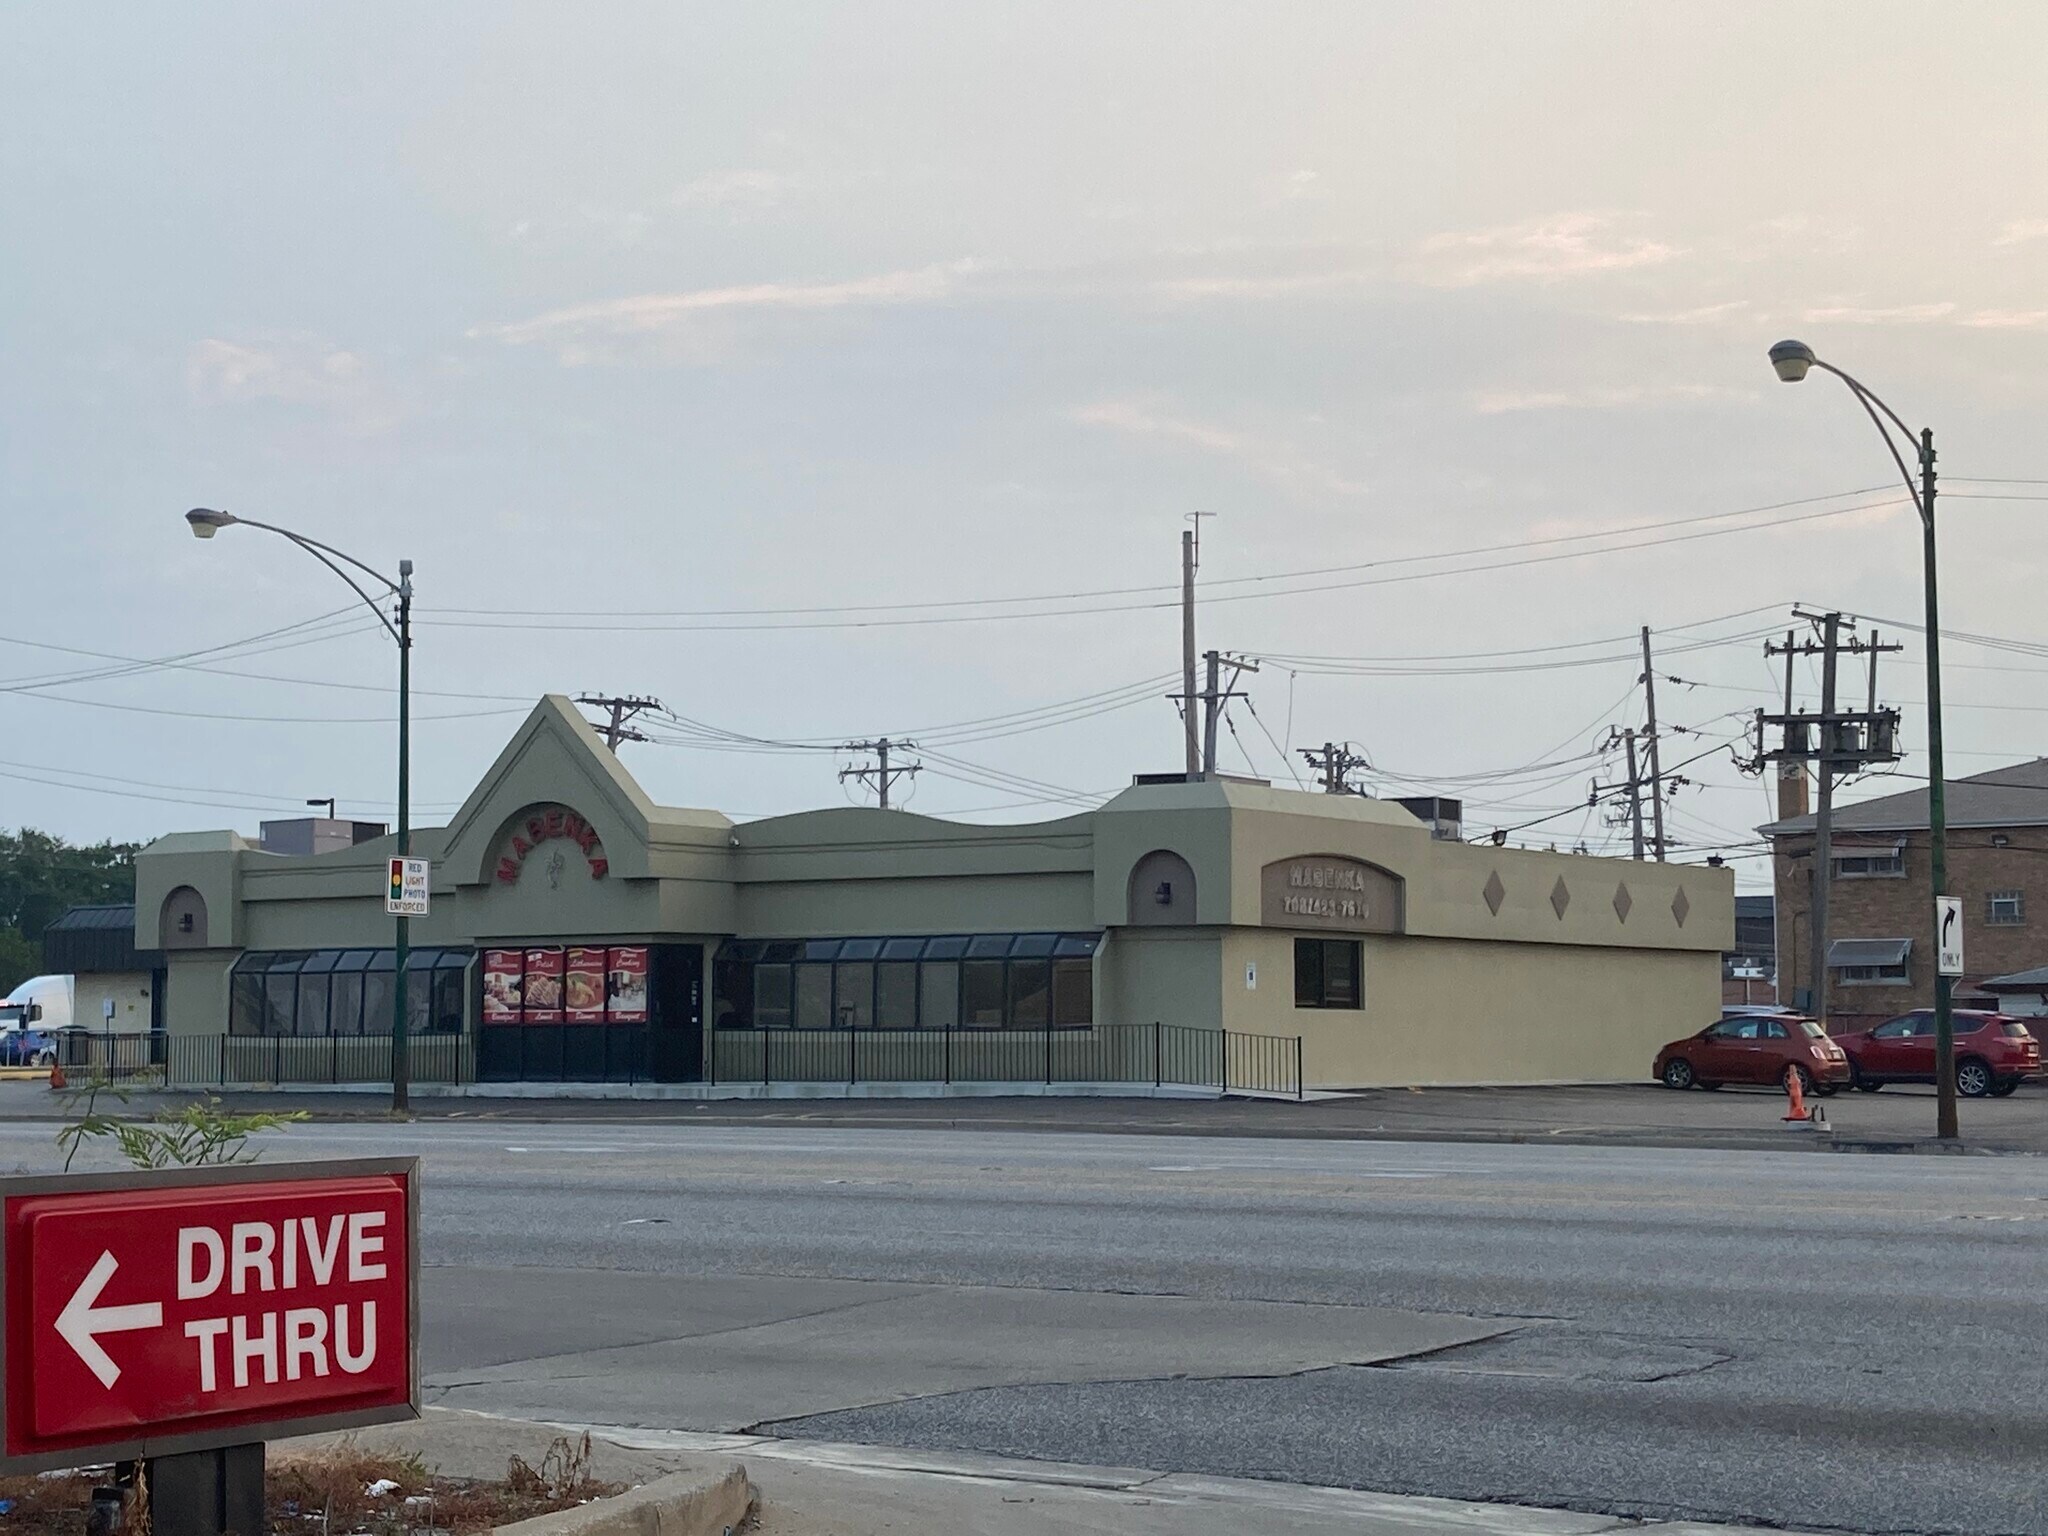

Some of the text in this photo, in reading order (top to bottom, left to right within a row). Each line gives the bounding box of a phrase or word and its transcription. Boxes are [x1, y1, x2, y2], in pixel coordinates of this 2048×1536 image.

[497, 809, 608, 883] MABENKA
[408, 862, 422, 873] RED
[405, 876, 425, 886] LIGHT
[1289, 864, 1365, 891] MABENKA
[404, 889, 426, 899] PHOTO
[390, 901, 425, 912] ENFORCED
[1942, 953, 1961, 968] ONLY
[177, 1210, 388, 1301] DRIVE
[184, 1300, 377, 1392] THRU
